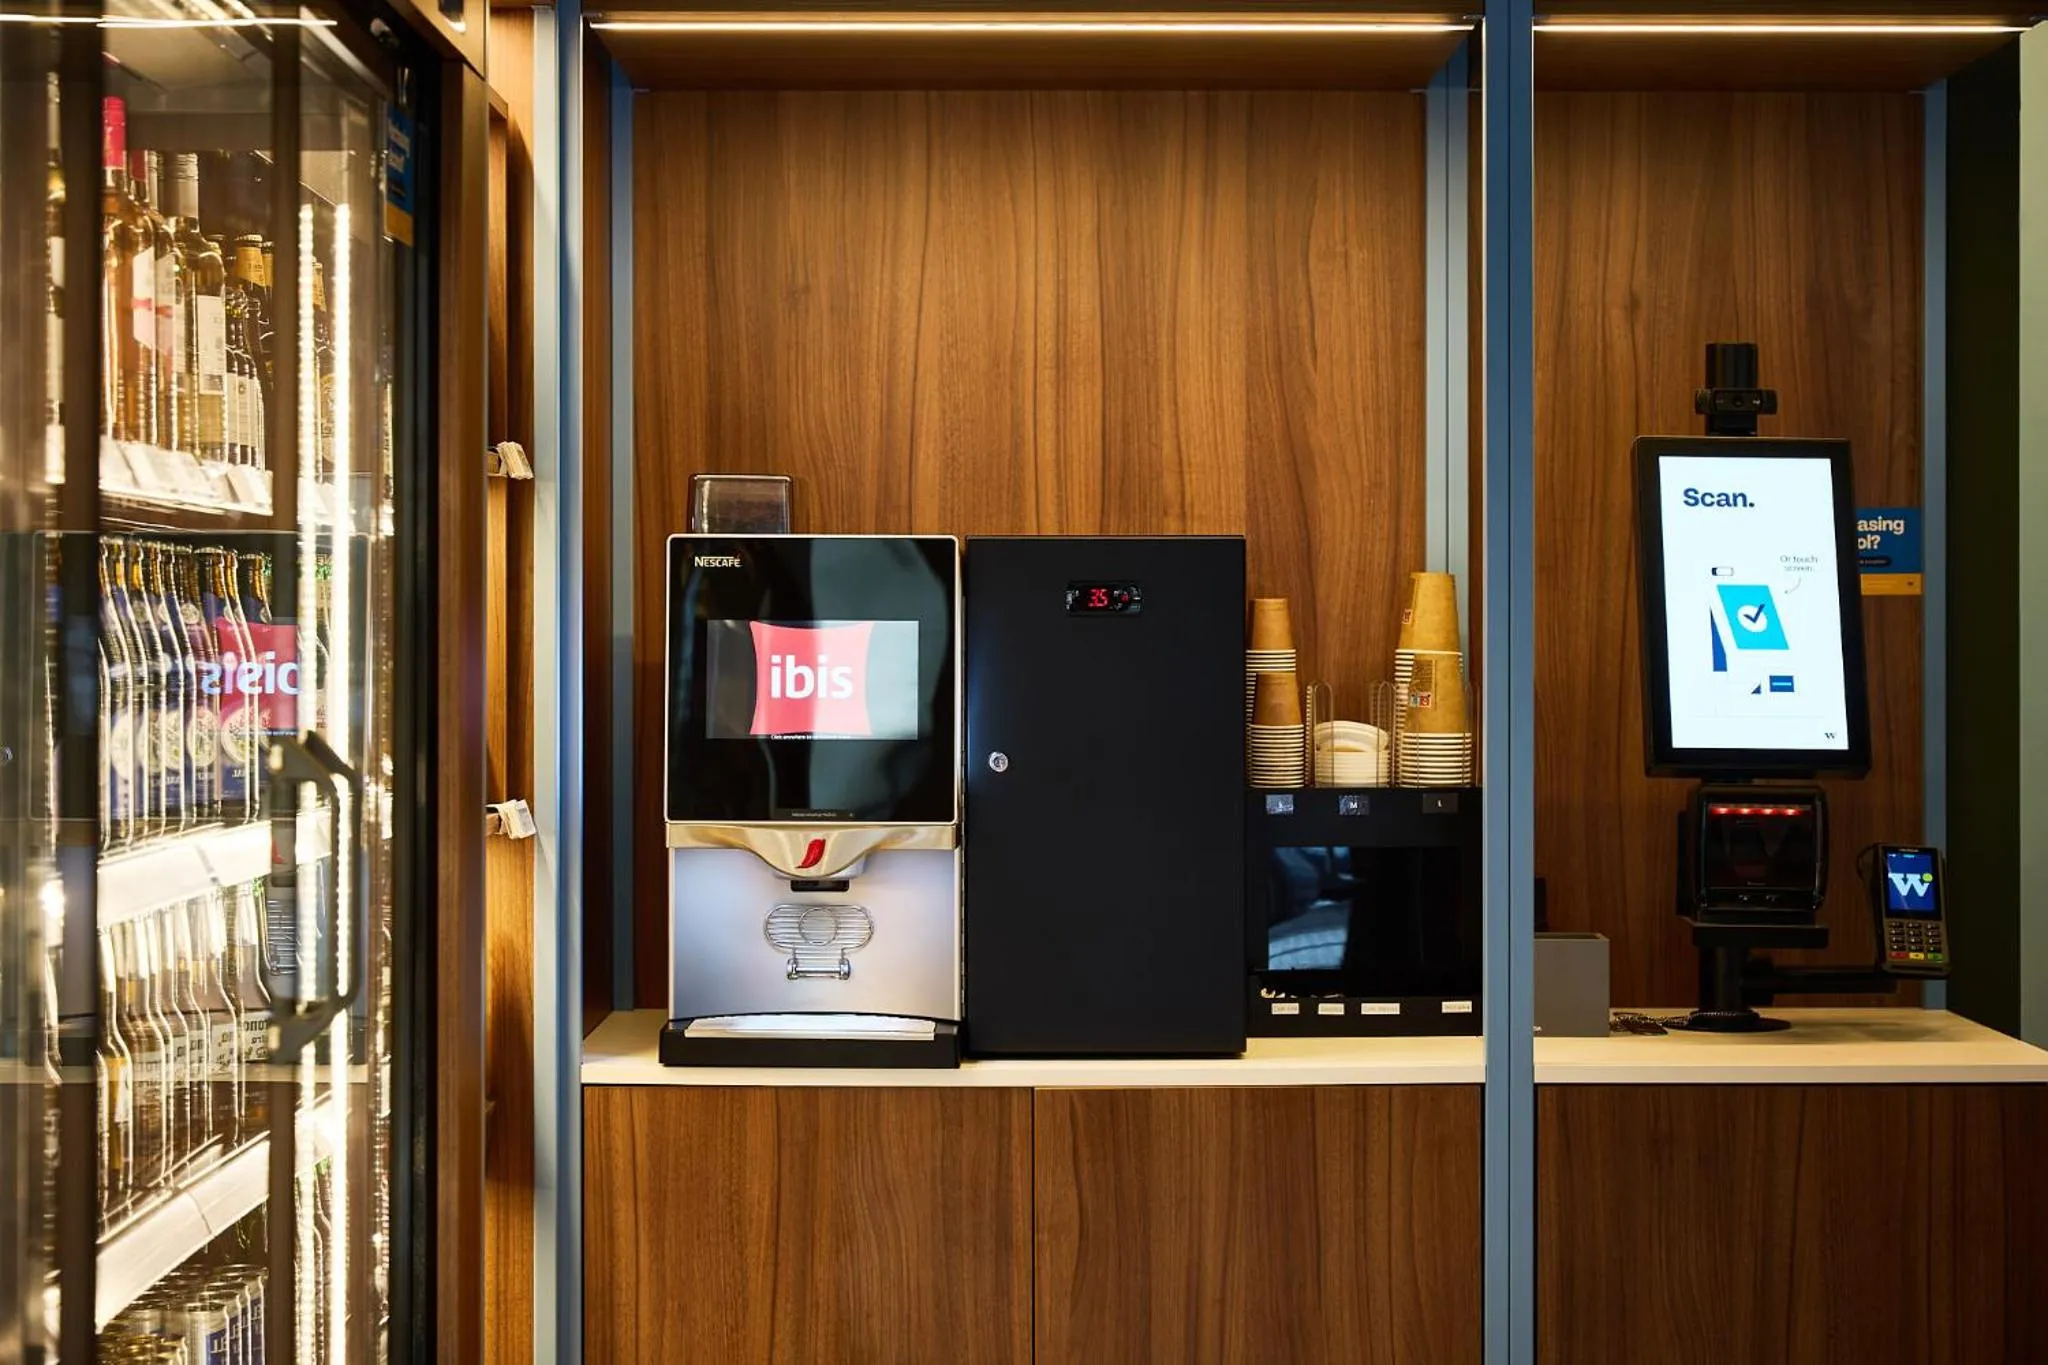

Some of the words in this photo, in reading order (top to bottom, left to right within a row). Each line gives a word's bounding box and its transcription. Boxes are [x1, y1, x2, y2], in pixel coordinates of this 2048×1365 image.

[1683, 487, 1756, 508] Scan.
[1857, 515, 1905, 535] asing
[770, 654, 854, 699] ibis
